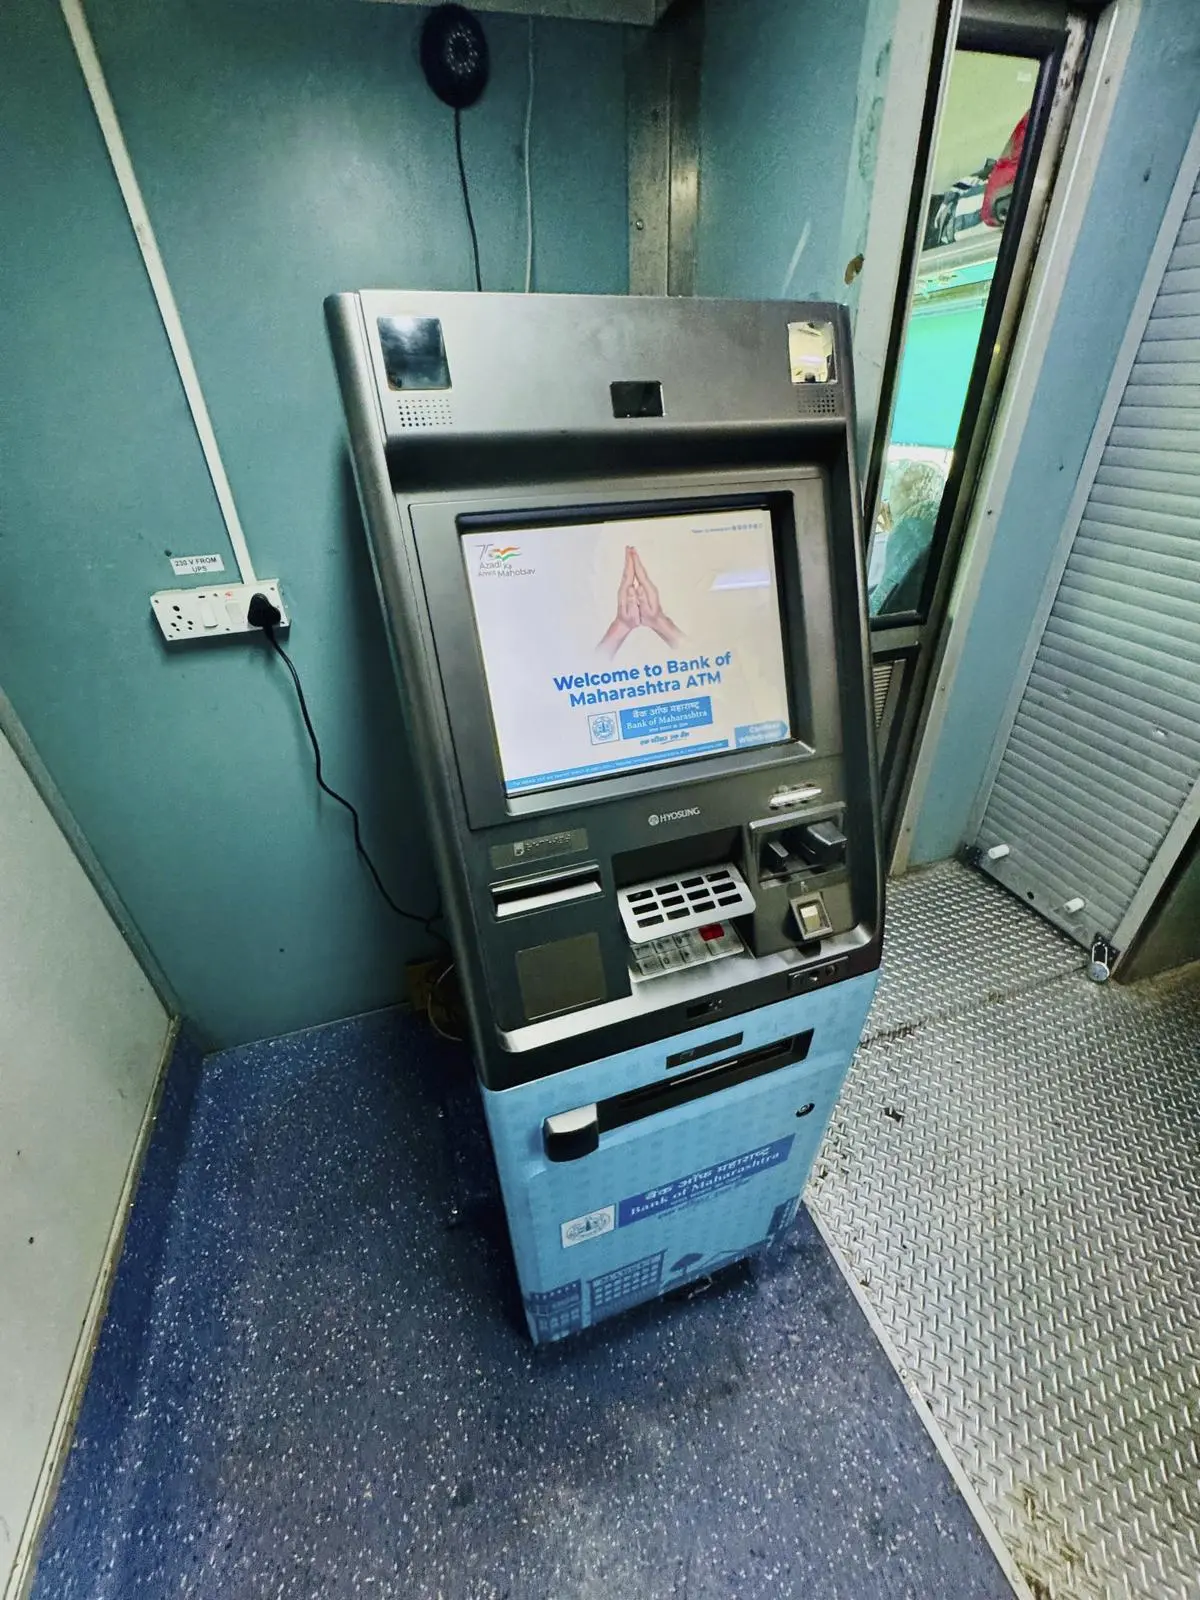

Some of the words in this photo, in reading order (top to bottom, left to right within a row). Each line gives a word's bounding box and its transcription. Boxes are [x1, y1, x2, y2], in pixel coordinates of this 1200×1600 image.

[192, 565, 208, 573] UPS
[553, 668, 640, 691] Welcome
[644, 664, 663, 678] to
[666, 655, 710, 674] Bank
[715, 651, 732, 666] of
[569, 680, 681, 707] Maharashtra
[686, 671, 722, 689] ATM
[626, 720, 647, 730] Bank
[648, 719, 657, 727] of
[658, 711, 708, 725] Maharashtra
[660, 806, 700, 823] HYOSUNG
[631, 1196, 670, 1216] Bank
[673, 1186, 688, 1198] of
[691, 1152, 780, 1194] Maharashtra
